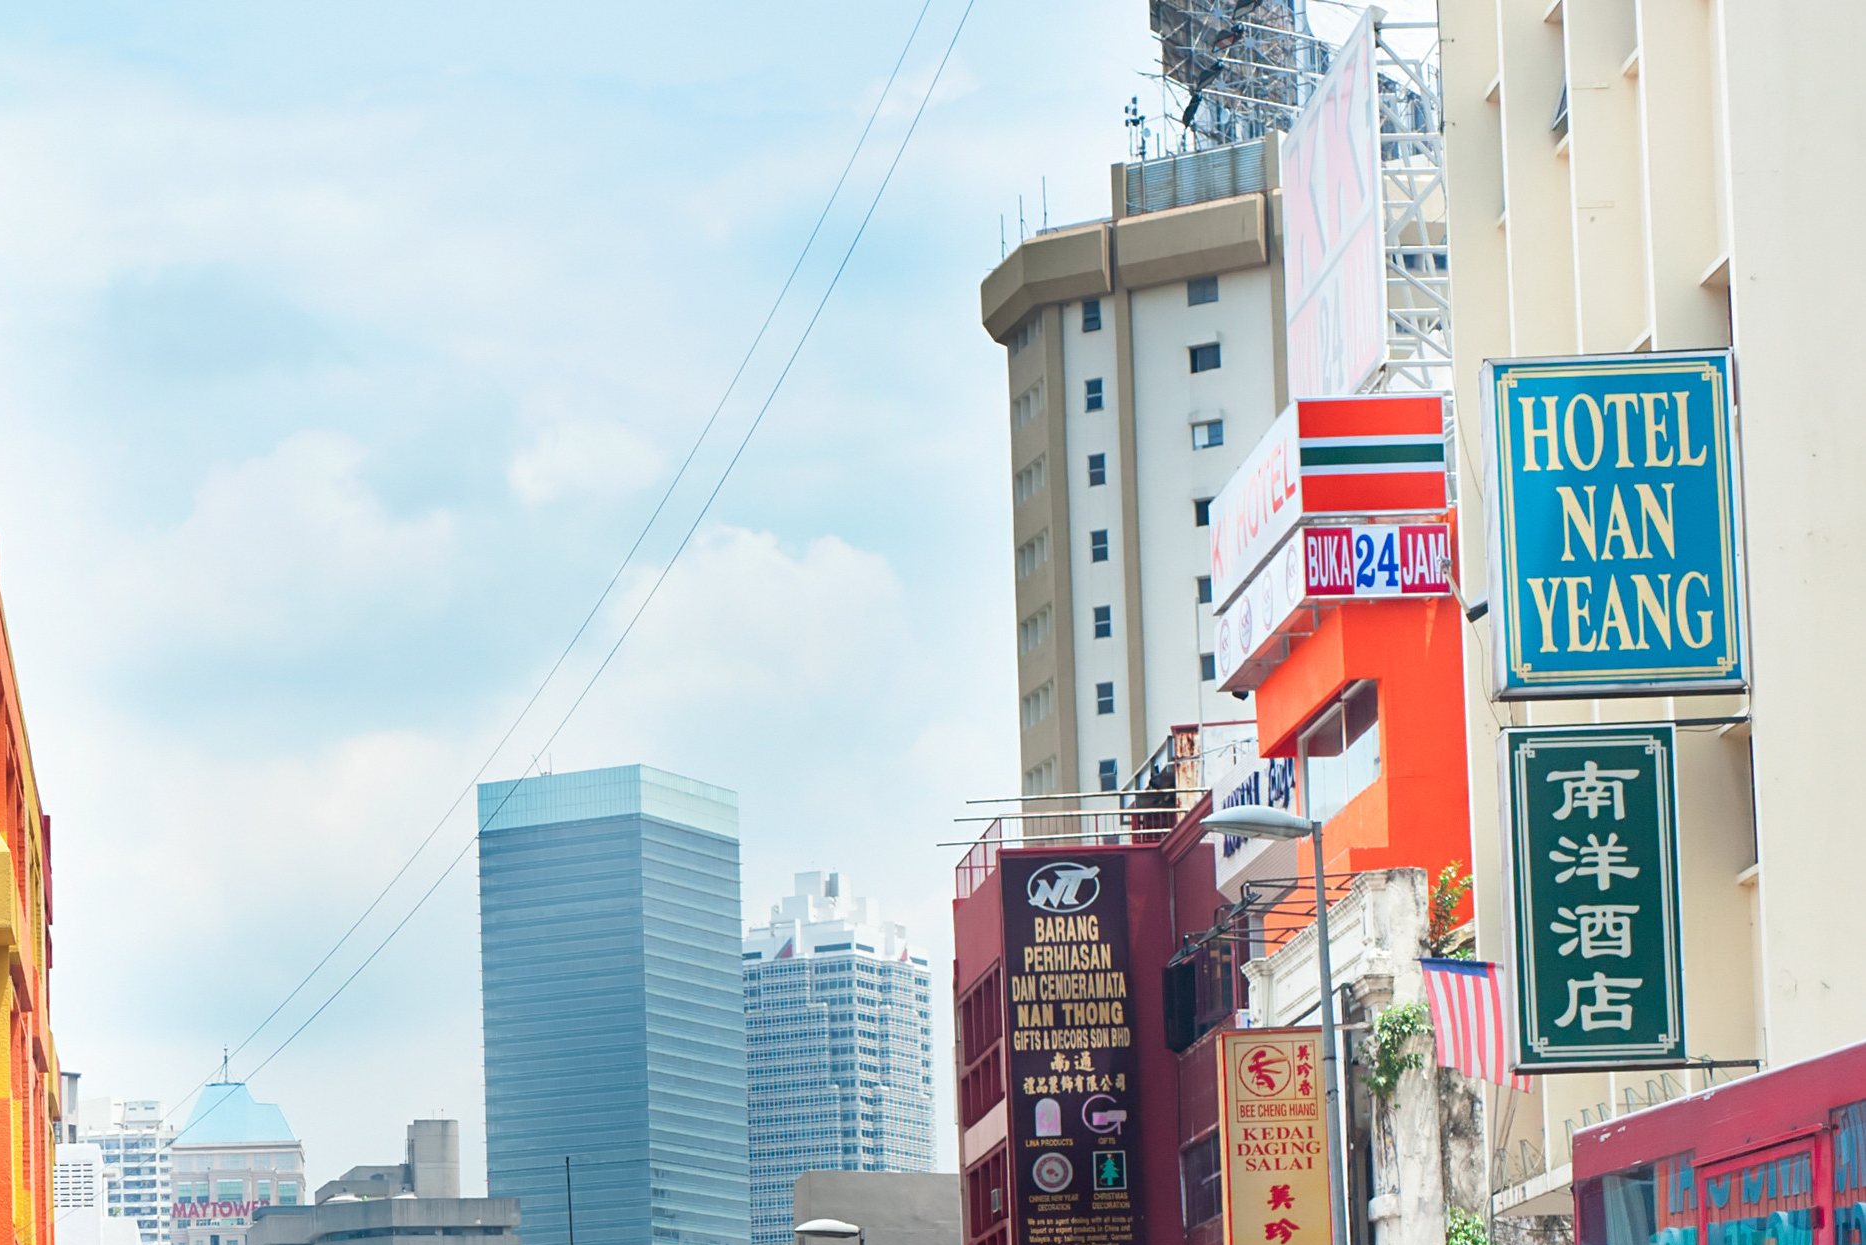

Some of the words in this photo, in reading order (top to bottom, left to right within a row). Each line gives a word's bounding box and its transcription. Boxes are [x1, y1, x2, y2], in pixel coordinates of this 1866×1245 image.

[1518, 390, 1709, 474] HOTEL
[1236, 437, 1296, 554] HOTEL
[1556, 482, 1676, 562] NAN
[1307, 536, 1352, 587] BUKA
[1356, 533, 1399, 588] 24
[1402, 533, 1447, 586] JAM
[1528, 571, 1716, 654] YEANG
[1546, 760, 1642, 1034] 南洋酒店
[1035, 915, 1099, 943] BARANG
[1024, 944, 1112, 972] PERHIASAN
[1012, 975, 1036, 1002] DAN
[1040, 972, 1127, 1001] CENDERAMATA
[1017, 1004, 1054, 1028] NAN
[1062, 1001, 1124, 1026] THONG
[1014, 1030, 1041, 1051] GIFTS
[1043, 1030, 1050, 1049] &
[1051, 1028, 1089, 1050] DECORS
[1090, 1027, 1110, 1048] SDN
[1111, 1027, 1130, 1047] BHD
[1240, 1105, 1257, 1118] BEE
[1258, 1103, 1287, 1117] CHENG
[1289, 1102, 1316, 1116] HIANG
[1243, 1126, 1315, 1141] KEDAI
[1237, 1141, 1321, 1156] DAGING
[1245, 1157, 1314, 1172] SALAI
